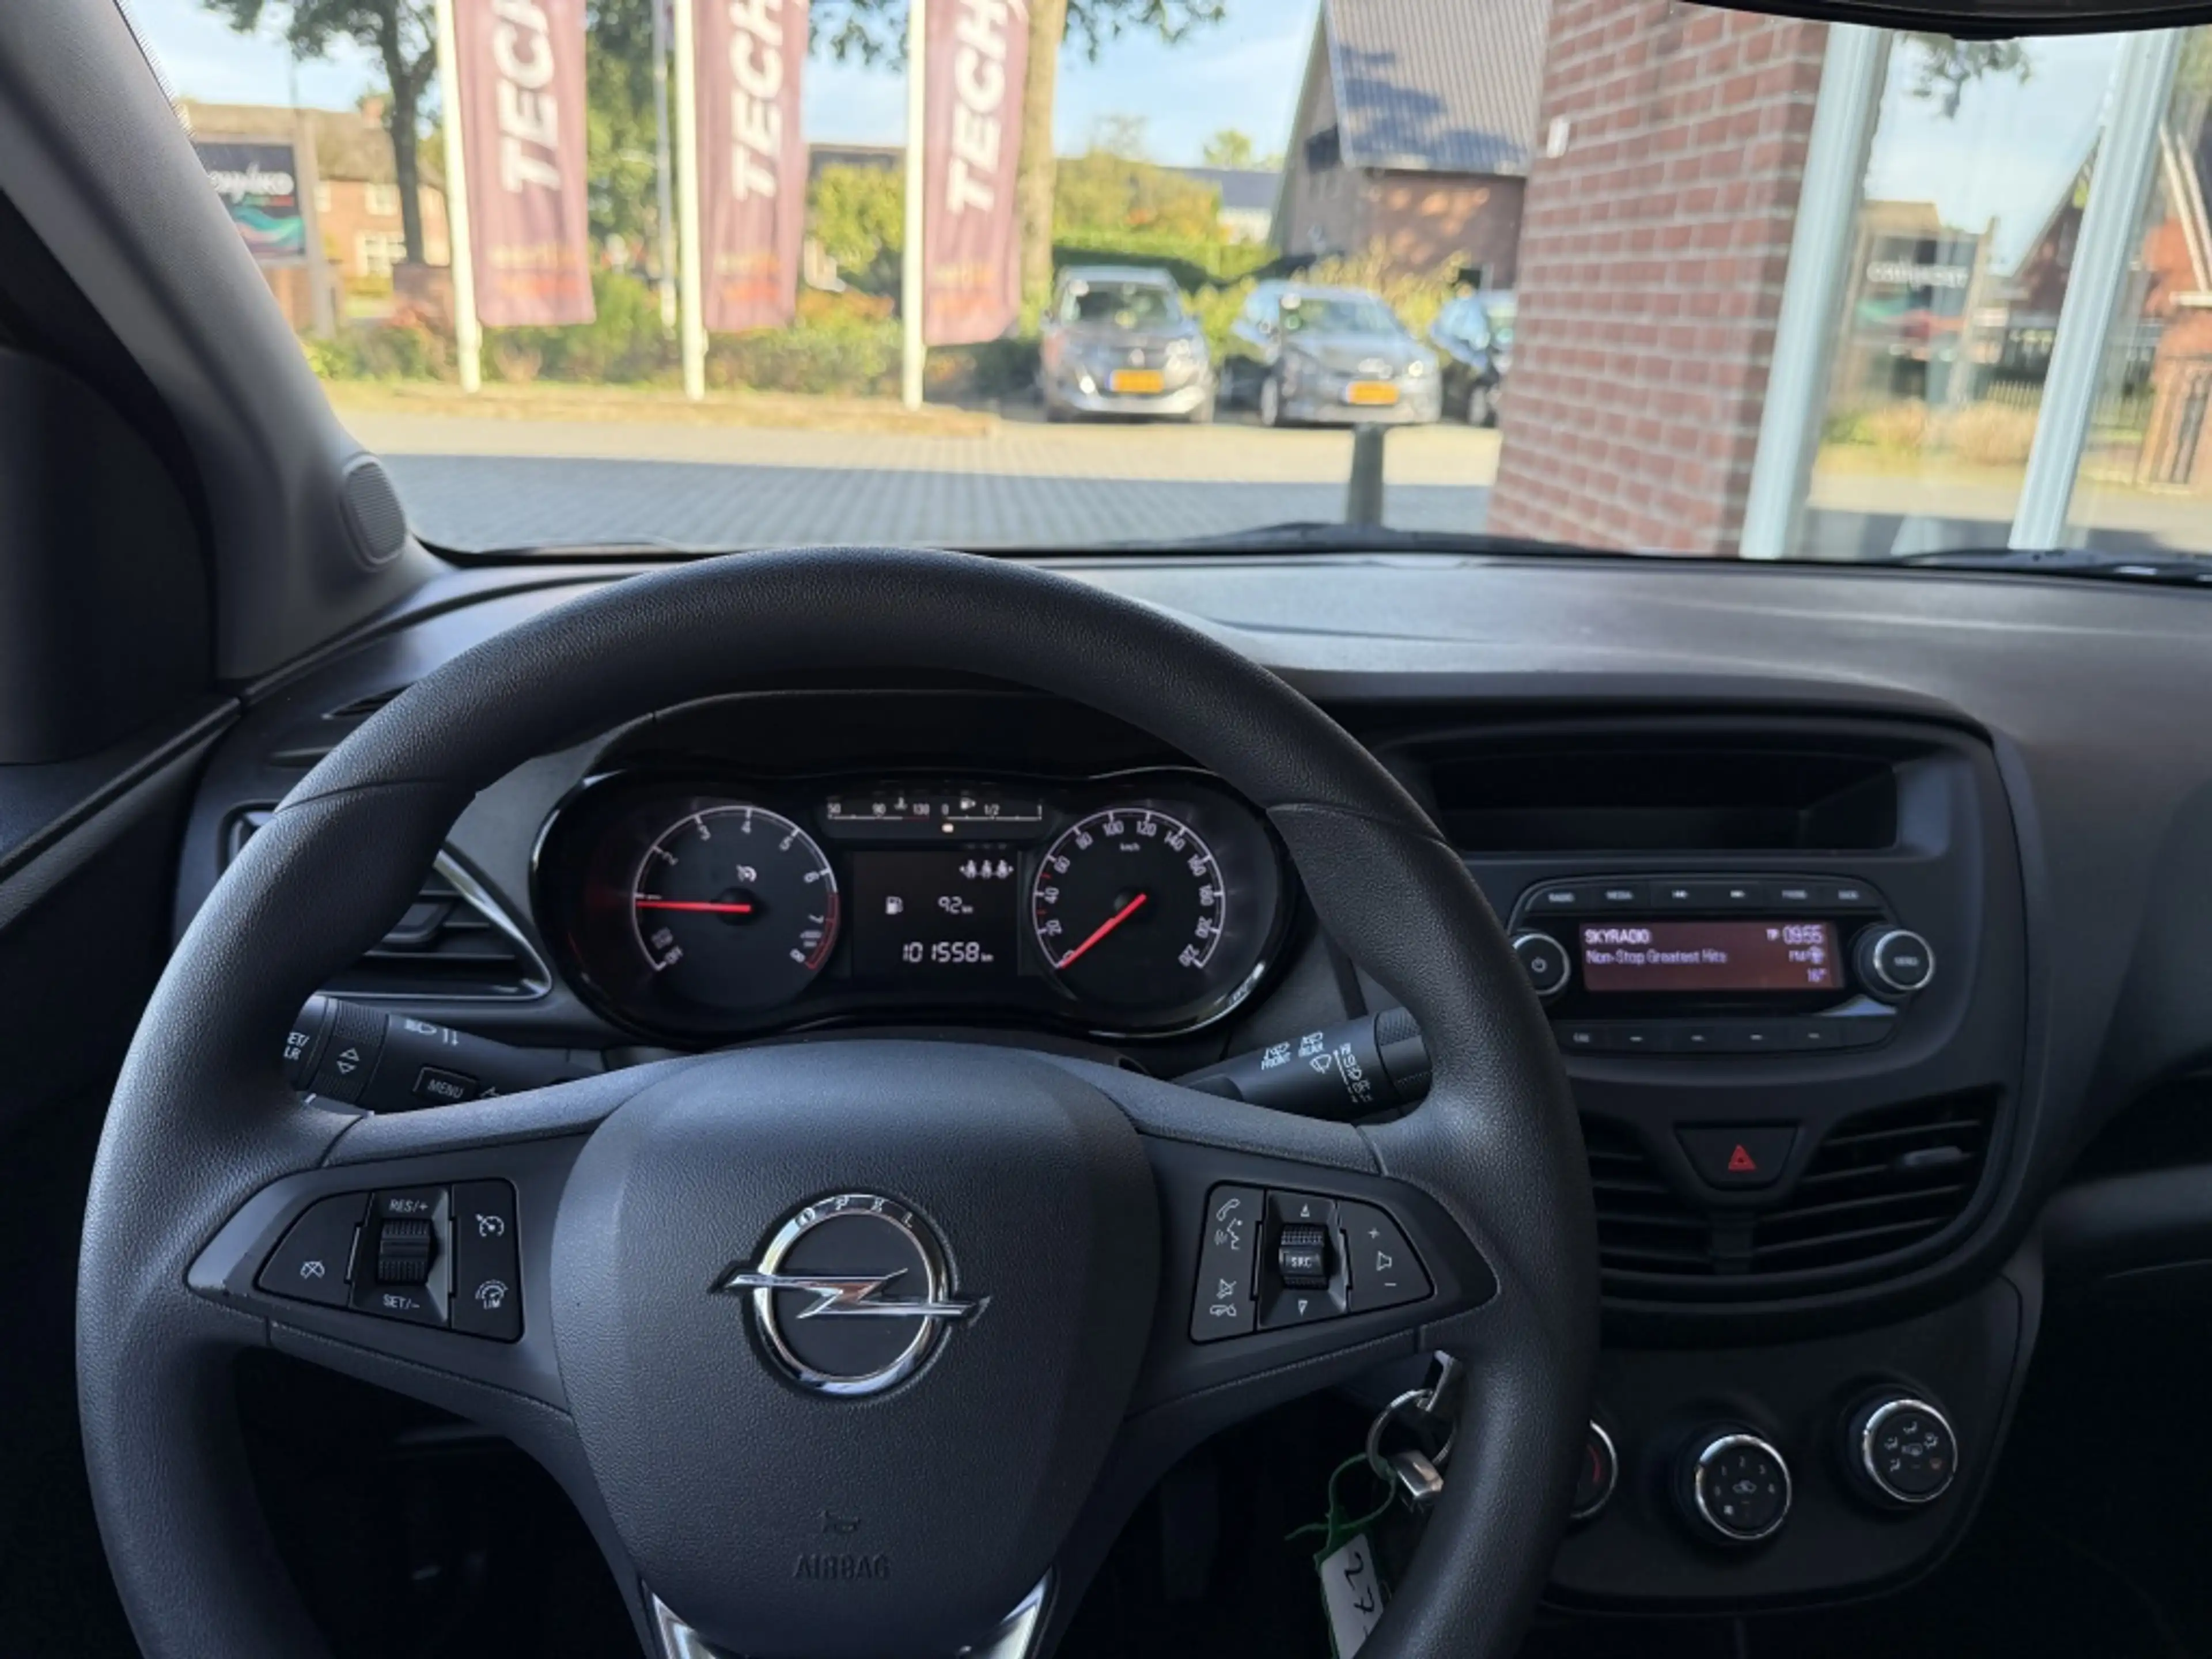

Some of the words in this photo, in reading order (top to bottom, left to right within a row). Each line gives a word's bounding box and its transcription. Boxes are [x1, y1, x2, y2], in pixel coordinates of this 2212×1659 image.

[698, 826, 711, 841] 3
[741, 819, 752, 833] 4
[1103, 820, 1124, 836] 100
[1137, 820, 1157, 837] 120
[779, 836, 793, 852] 5
[1075, 832, 1093, 850] 80
[1164, 831, 1186, 851] 140
[662, 851, 679, 865] 2
[1054, 855, 1070, 874] 60
[1187, 854, 1206, 877] 160
[804, 872, 819, 883] 6
[1044, 887, 1059, 904] 40
[1199, 885, 1214, 906] 180
[938, 896, 963, 914] 92
[808, 914, 824, 924] 7
[1046, 919, 1062, 936] 20
[789, 948, 805, 963] 8
[903, 942, 980, 963] 101558
[1585, 949, 1645, 965] Non-Stop
[1646, 948, 1700, 964] Greatest
[1701, 948, 1728, 964] Hits
[427, 1078, 465, 1099] MENU
[795, 1195, 914, 1229] OPEL
[1290, 1256, 1312, 1268] SRC
[791, 1554, 891, 1580] AIRBAG
